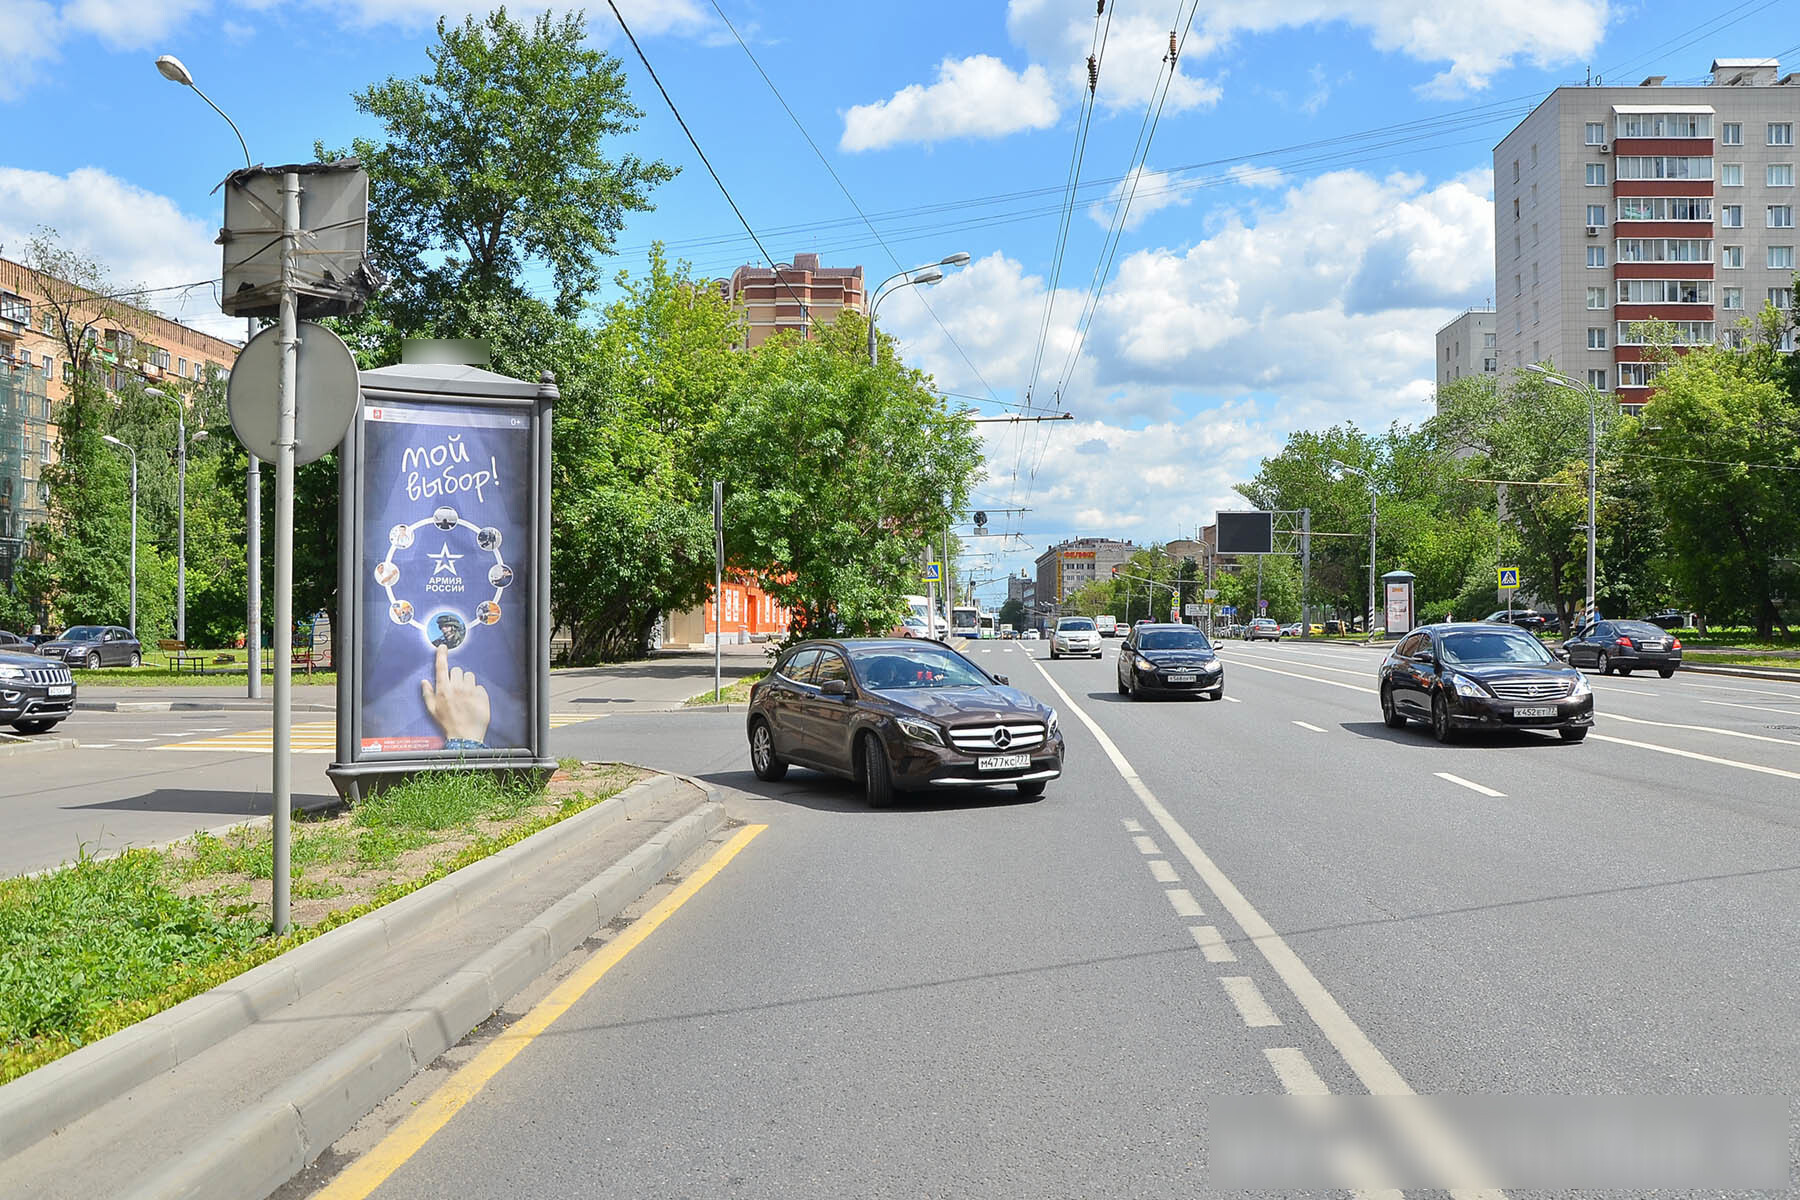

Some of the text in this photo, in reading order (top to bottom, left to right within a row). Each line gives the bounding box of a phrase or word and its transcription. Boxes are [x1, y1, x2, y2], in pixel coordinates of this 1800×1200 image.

[405, 456, 500, 503] выбор!
[428, 576, 463, 585] АРМИЯ
[425, 584, 465, 592] РОССИИ
